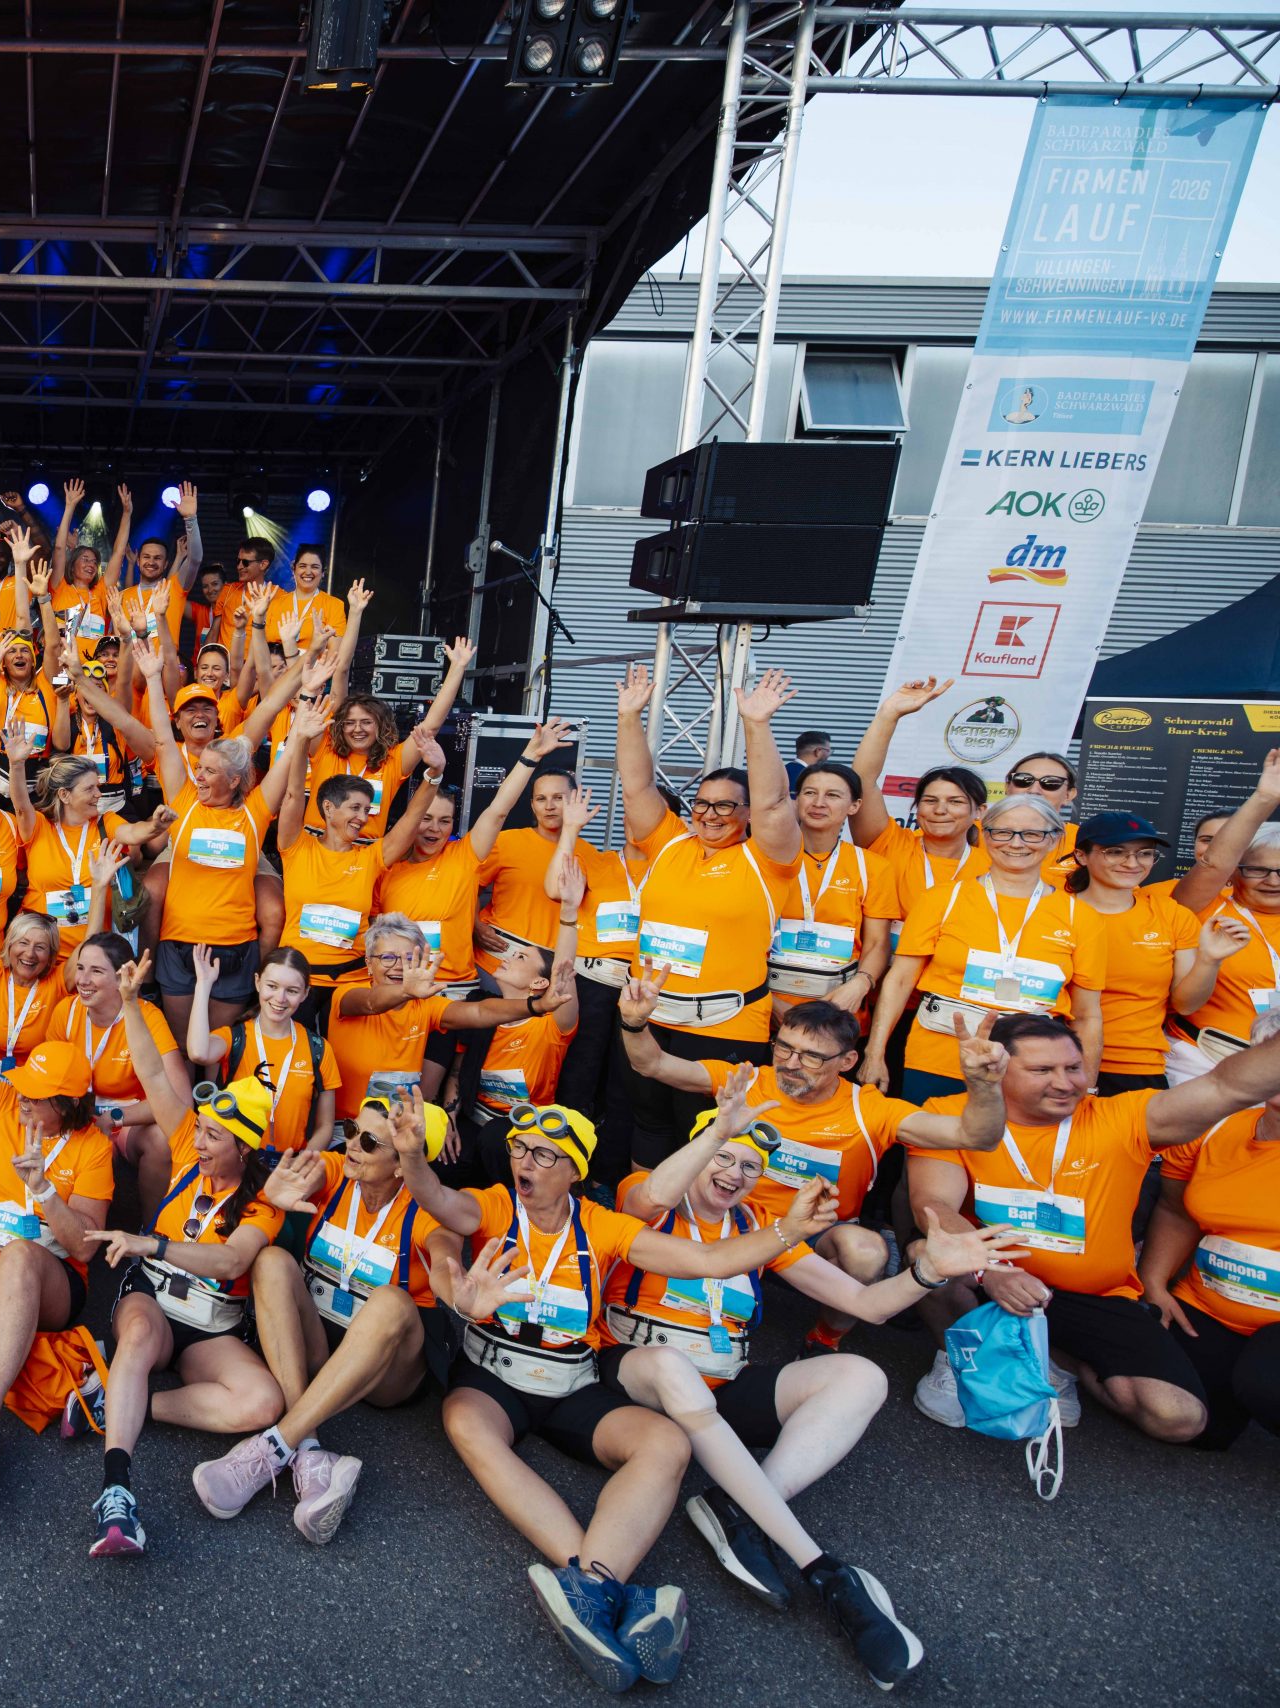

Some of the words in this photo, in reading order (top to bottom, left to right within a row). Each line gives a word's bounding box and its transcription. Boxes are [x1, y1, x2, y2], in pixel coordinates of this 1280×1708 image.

[1046, 124, 1171, 140] BADEPARADIES
[1042, 139, 1169, 154] SCHWARZWALD
[1045, 167, 1150, 195] FIRMEN
[1169, 179, 1212, 201] 2026
[1033, 203, 1142, 243] LAUF
[1034, 258, 1116, 276] VILLINGEN-
[1015, 277, 1125, 294] SCHWENNINGEN
[1000, 308, 1188, 329] WWW.FIRMENLAUF-VS.DE
[1057, 391, 1146, 403] BADEPARADIES
[1055, 400, 1144, 412] SCHWARZWALD
[986, 449, 1053, 468] KERN
[1059, 450, 1147, 472] LIEBERS
[985, 490, 1067, 518] AOK
[1005, 534, 1068, 568] dm
[973, 652, 1037, 666] Kaufland
[1096, 711, 1152, 726] Cocktail
[1163, 716, 1234, 726] Schwarzwald
[950, 725, 1016, 739] KETTERER
[1167, 727, 1228, 737] Baar-Kreis
[964, 737, 996, 748] BIER
[206, 840, 230, 851] Tanja
[650, 936, 686, 952] Blanka
[776, 1152, 808, 1172] Jörg
[1207, 1253, 1267, 1282] Ramona
